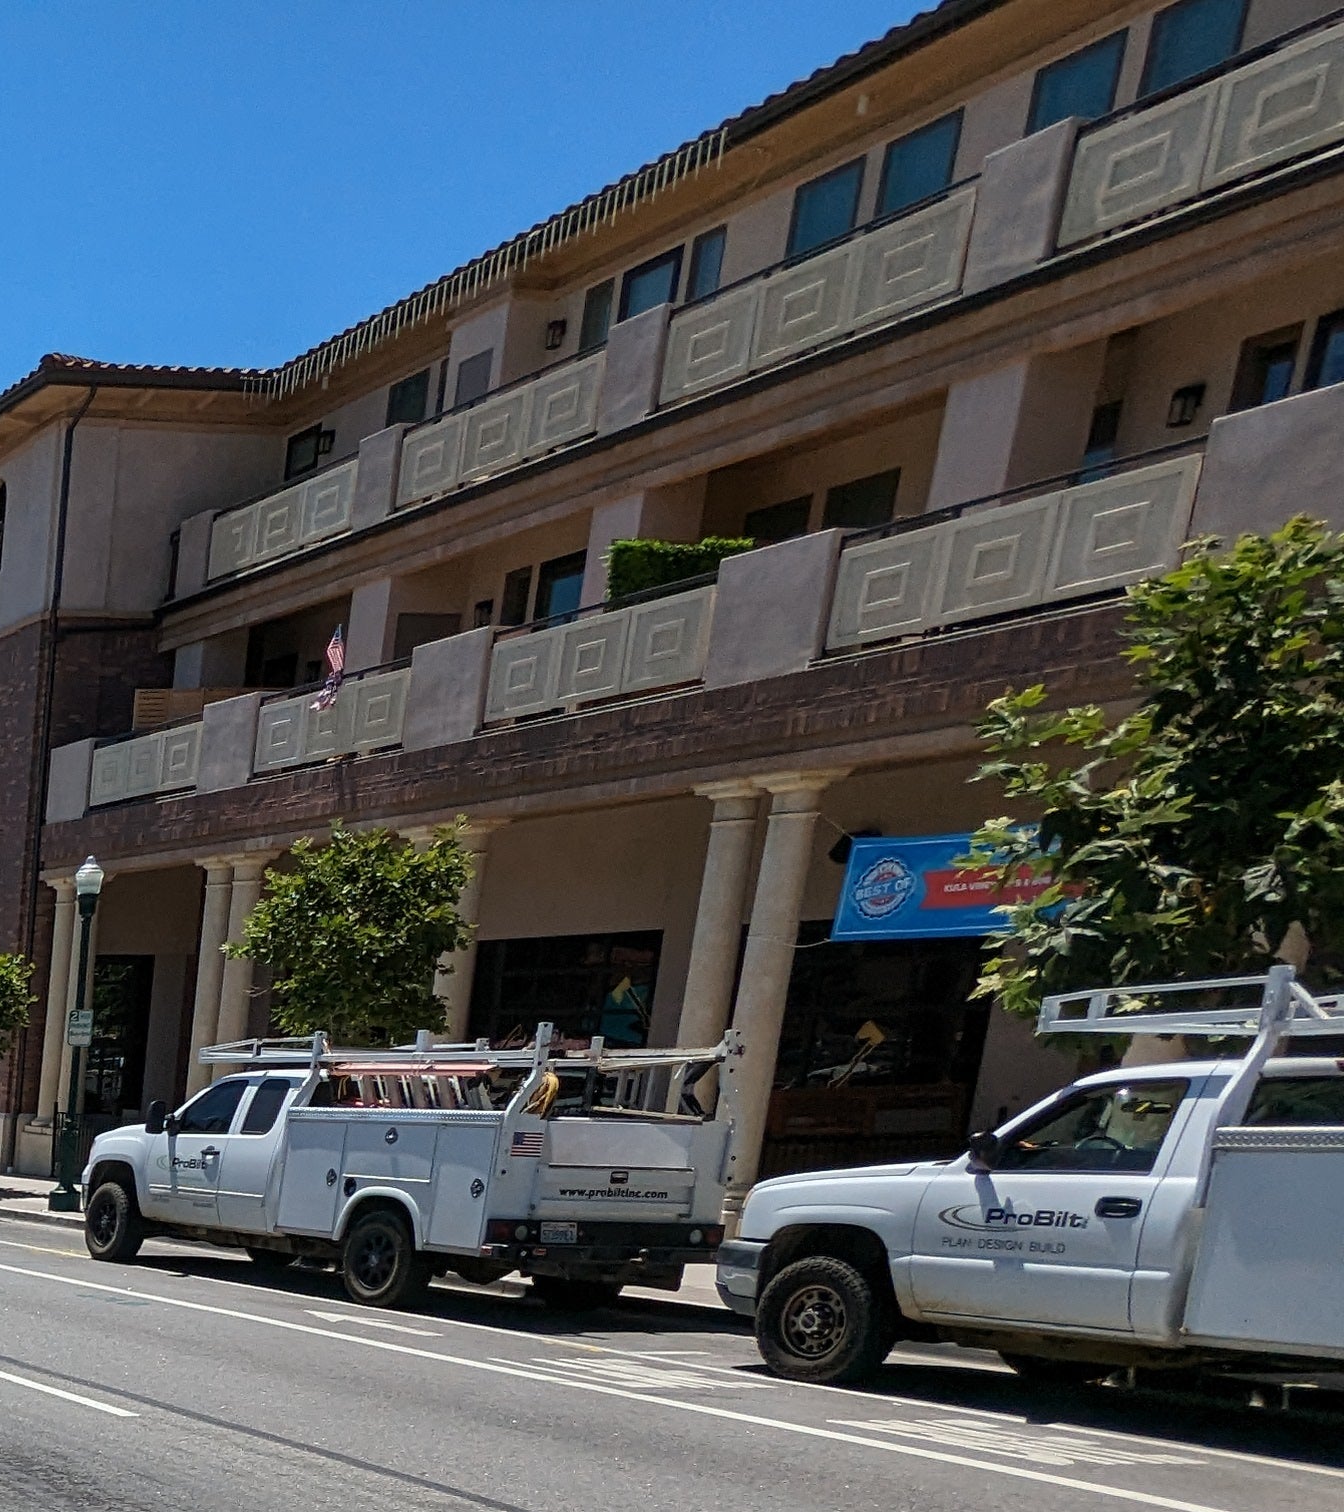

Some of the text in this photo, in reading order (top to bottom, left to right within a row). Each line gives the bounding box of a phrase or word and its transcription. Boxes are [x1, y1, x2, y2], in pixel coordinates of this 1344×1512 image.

[855, 882, 892, 900] BEST
[70, 1011, 79, 1021] 2
[559, 1187, 668, 1200] www.probiltinc.com
[984, 1207, 1081, 1229] ProBilt
[941, 1236, 1066, 1255] PLAN DESIGN BUILD
